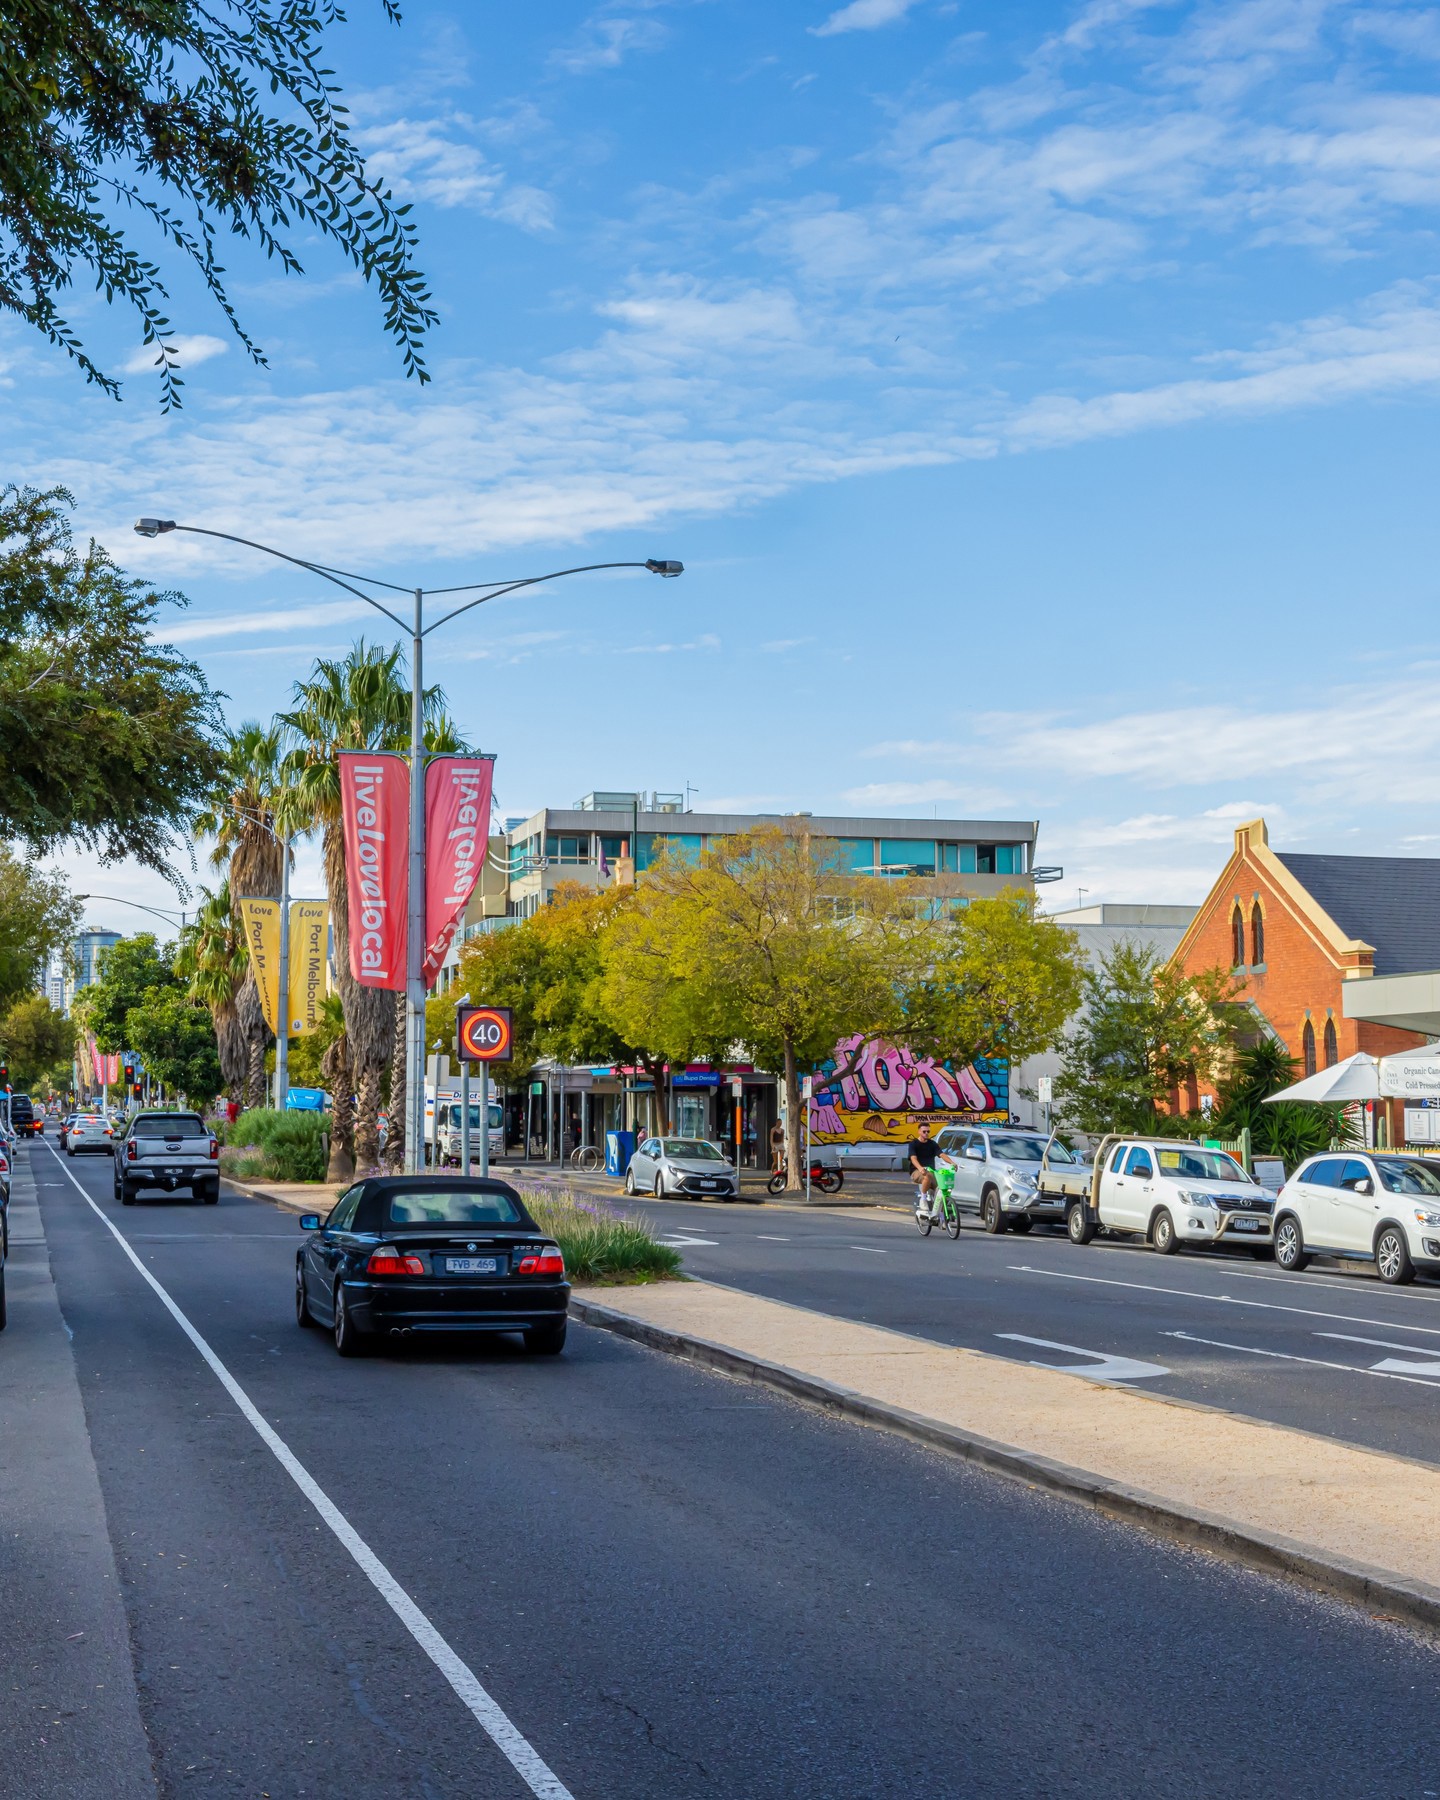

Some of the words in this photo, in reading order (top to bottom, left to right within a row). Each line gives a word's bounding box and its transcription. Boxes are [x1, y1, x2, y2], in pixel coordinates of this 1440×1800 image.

[309, 924, 322, 954] Port
[472, 1024, 501, 1044] 40
[1403, 1066, 1427, 1077] Organic
[1405, 1081, 1418, 1089] Cold
